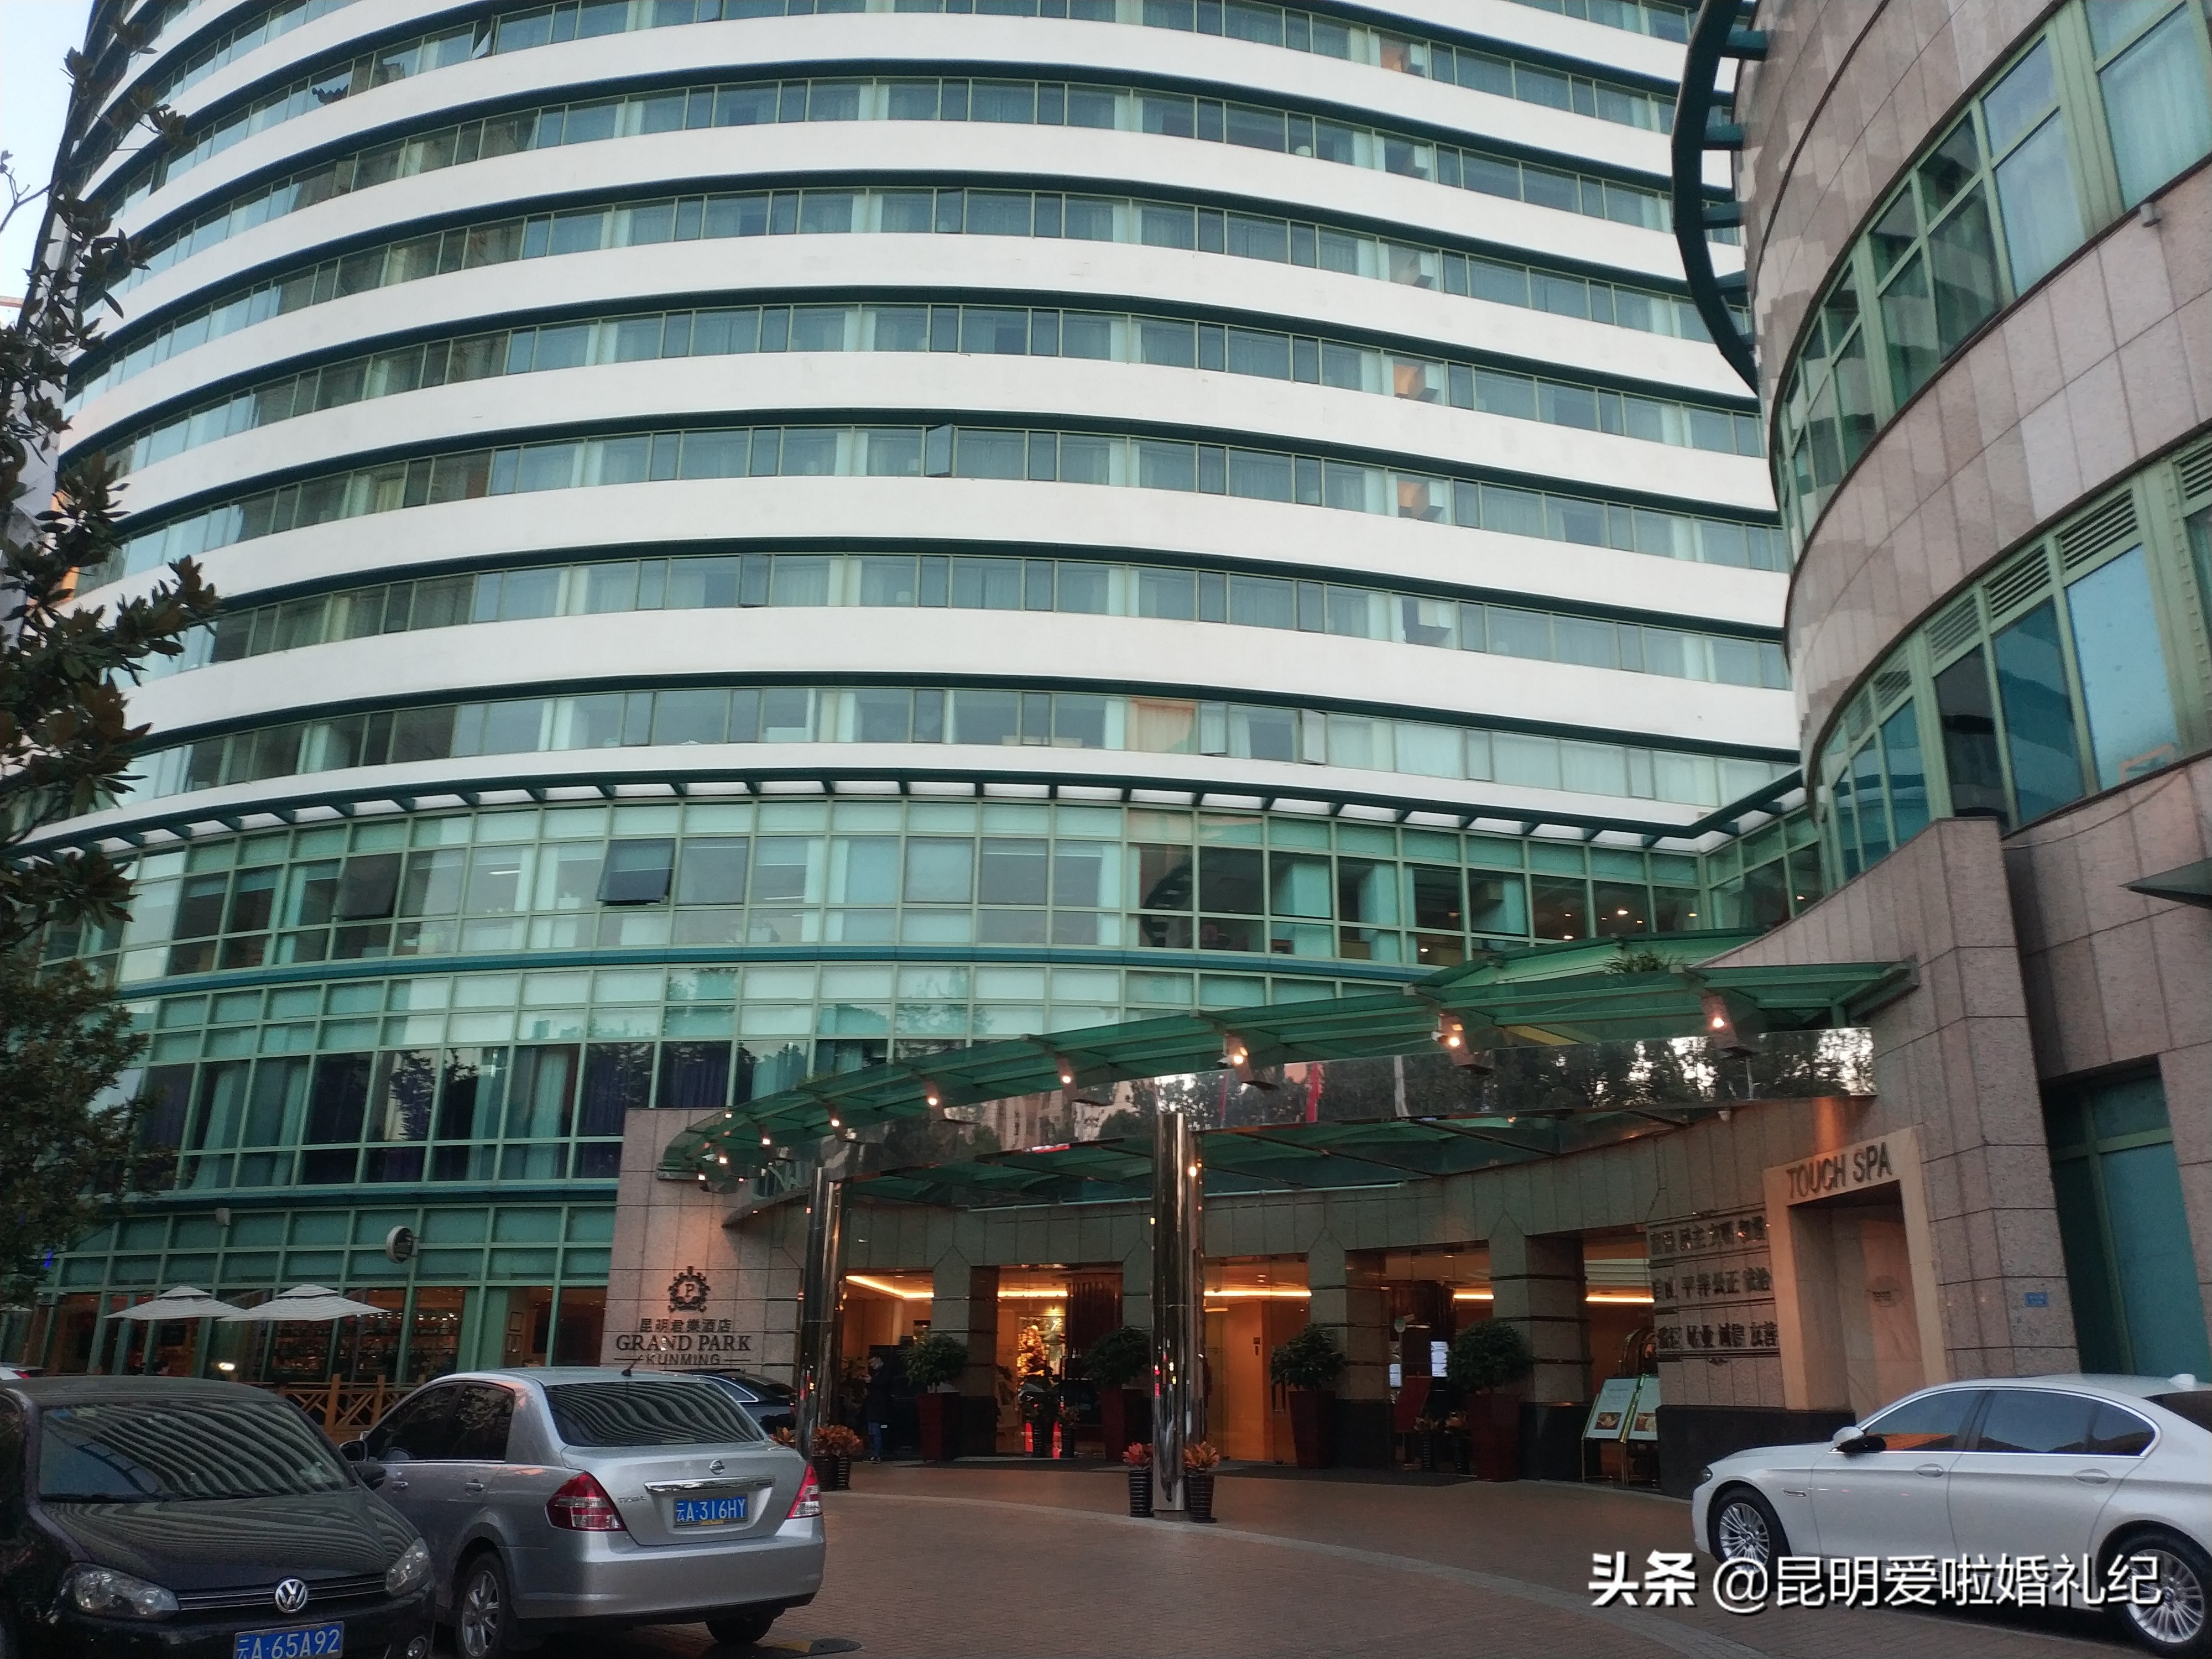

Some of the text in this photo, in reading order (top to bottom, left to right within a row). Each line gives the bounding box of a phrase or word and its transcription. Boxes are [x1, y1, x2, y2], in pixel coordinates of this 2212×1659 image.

[1786, 1142, 1893, 1199] TOUCH SPA
[615, 1334, 752, 1351] GRAND PARK
[645, 1354, 720, 1365] KUNMING
